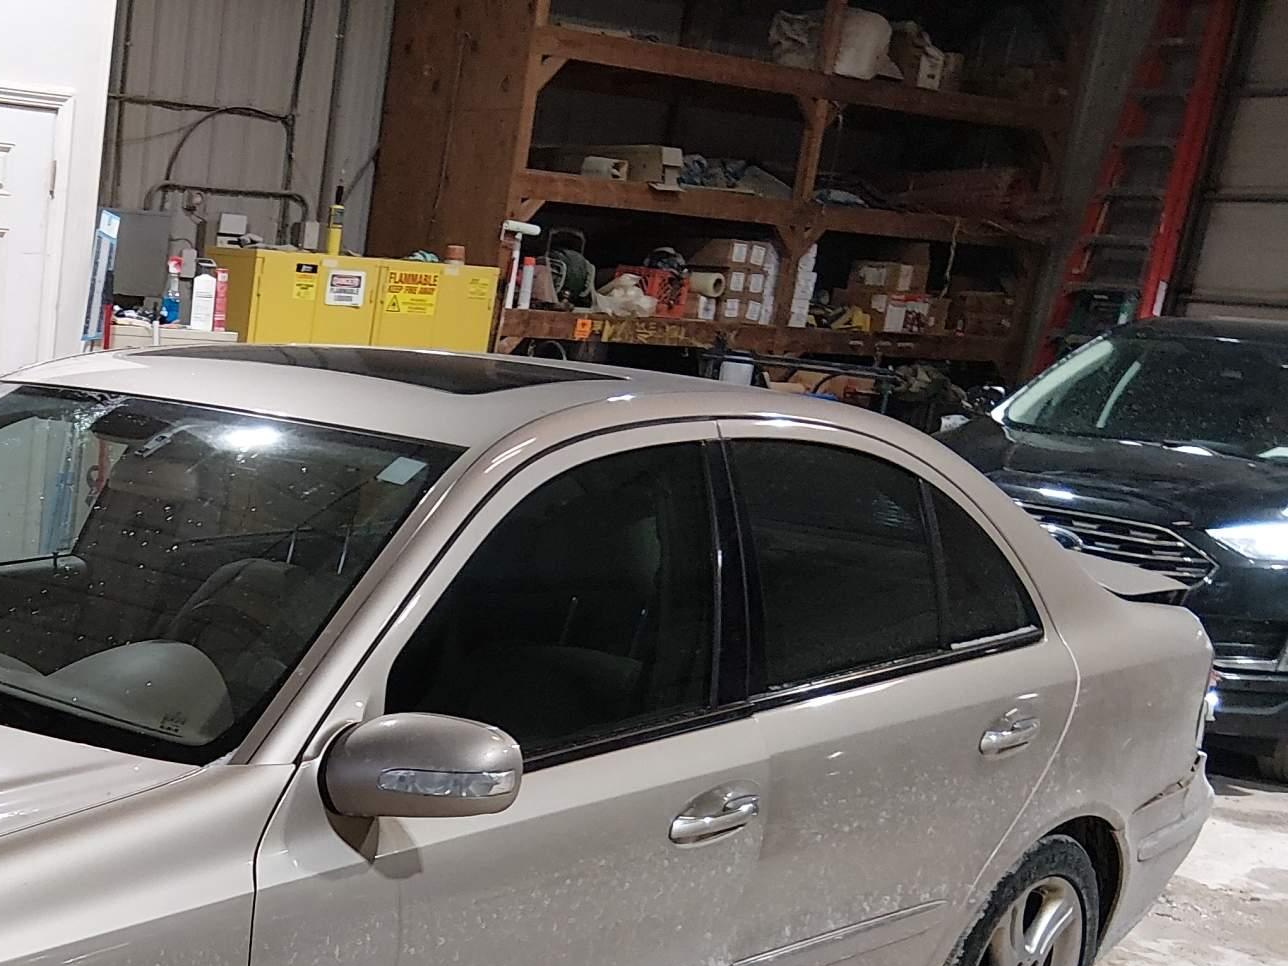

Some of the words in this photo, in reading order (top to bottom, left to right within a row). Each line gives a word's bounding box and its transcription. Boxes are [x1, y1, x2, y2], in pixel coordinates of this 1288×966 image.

[389, 271, 439, 286] FLAMMABLE
[388, 285, 403, 293] KEEP
[404, 286, 418, 294] FIRE
